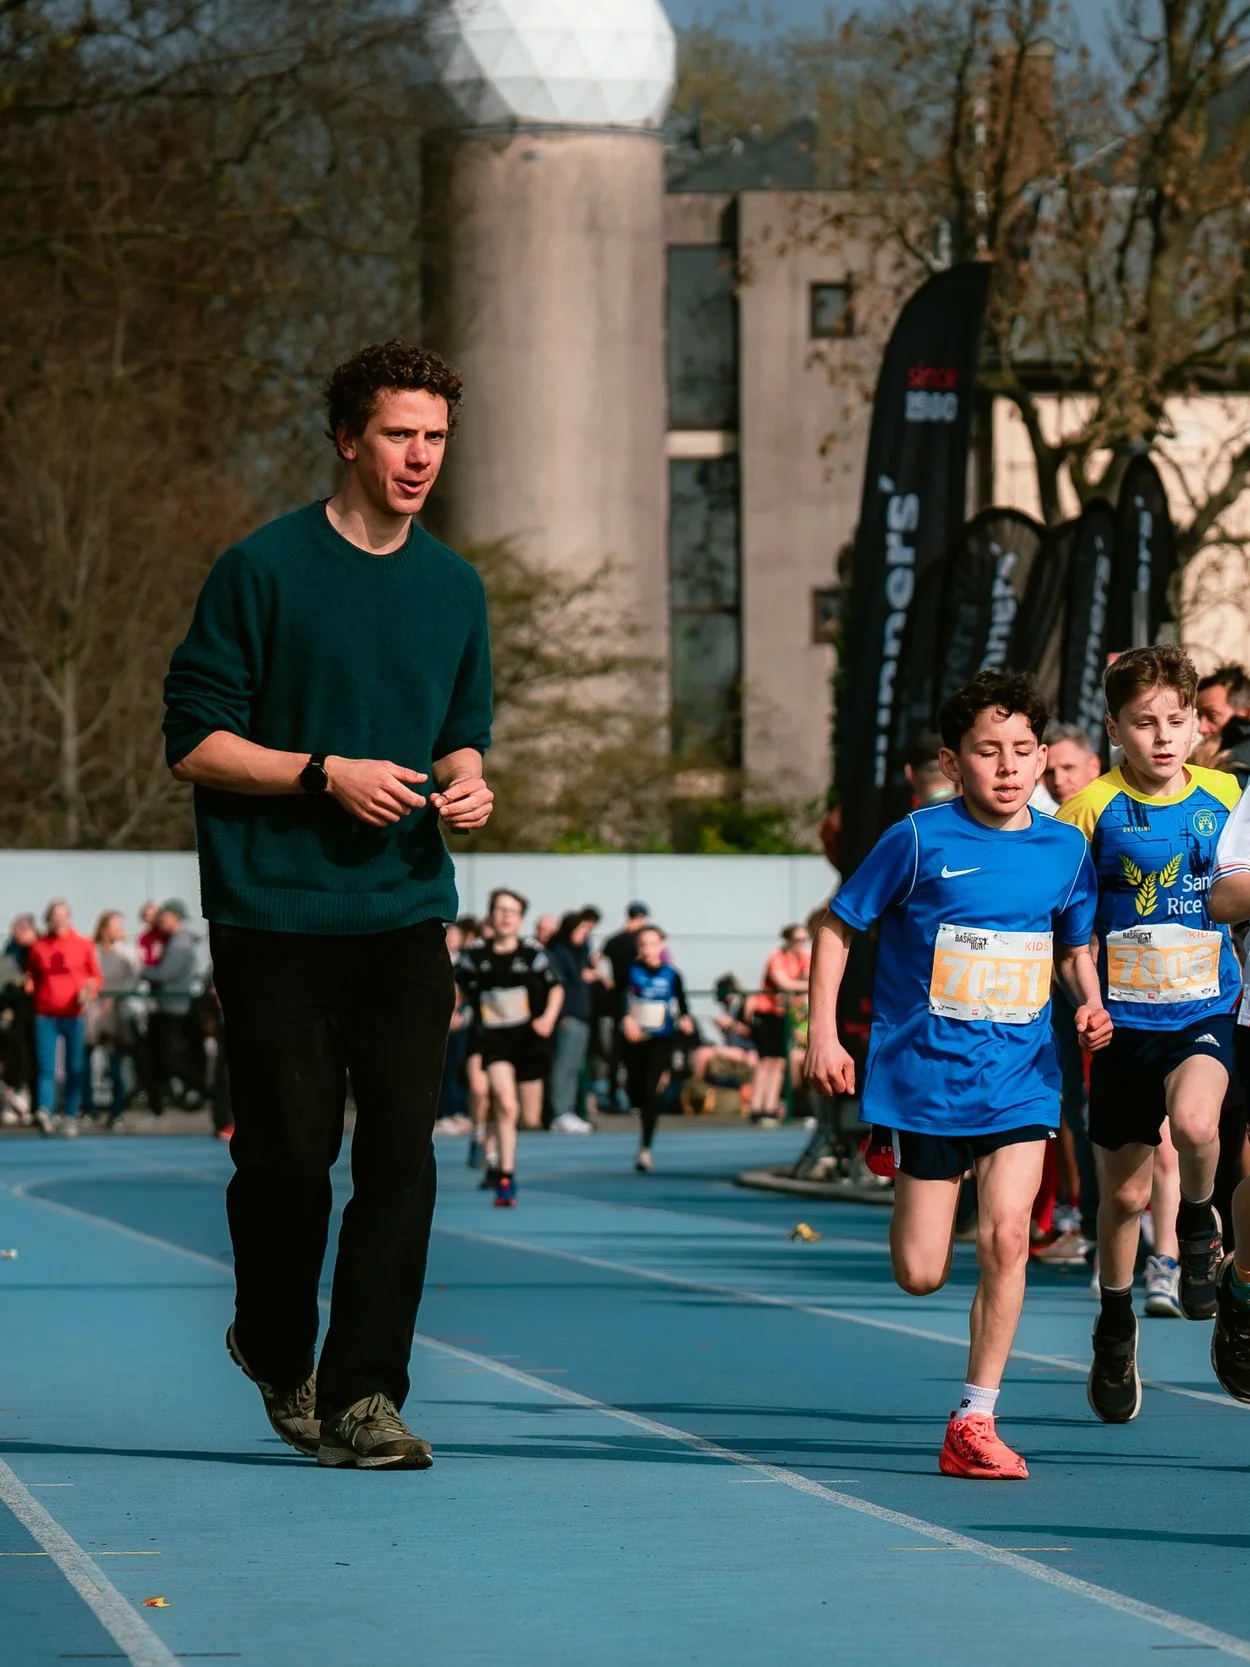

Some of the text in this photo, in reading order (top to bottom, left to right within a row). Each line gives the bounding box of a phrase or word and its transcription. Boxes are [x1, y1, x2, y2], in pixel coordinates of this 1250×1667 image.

[1182, 874, 1211, 893] San
[1167, 895, 1202, 915] Rice
[1024, 940, 1050, 952] KIDS
[942, 955, 1041, 1004] 7051
